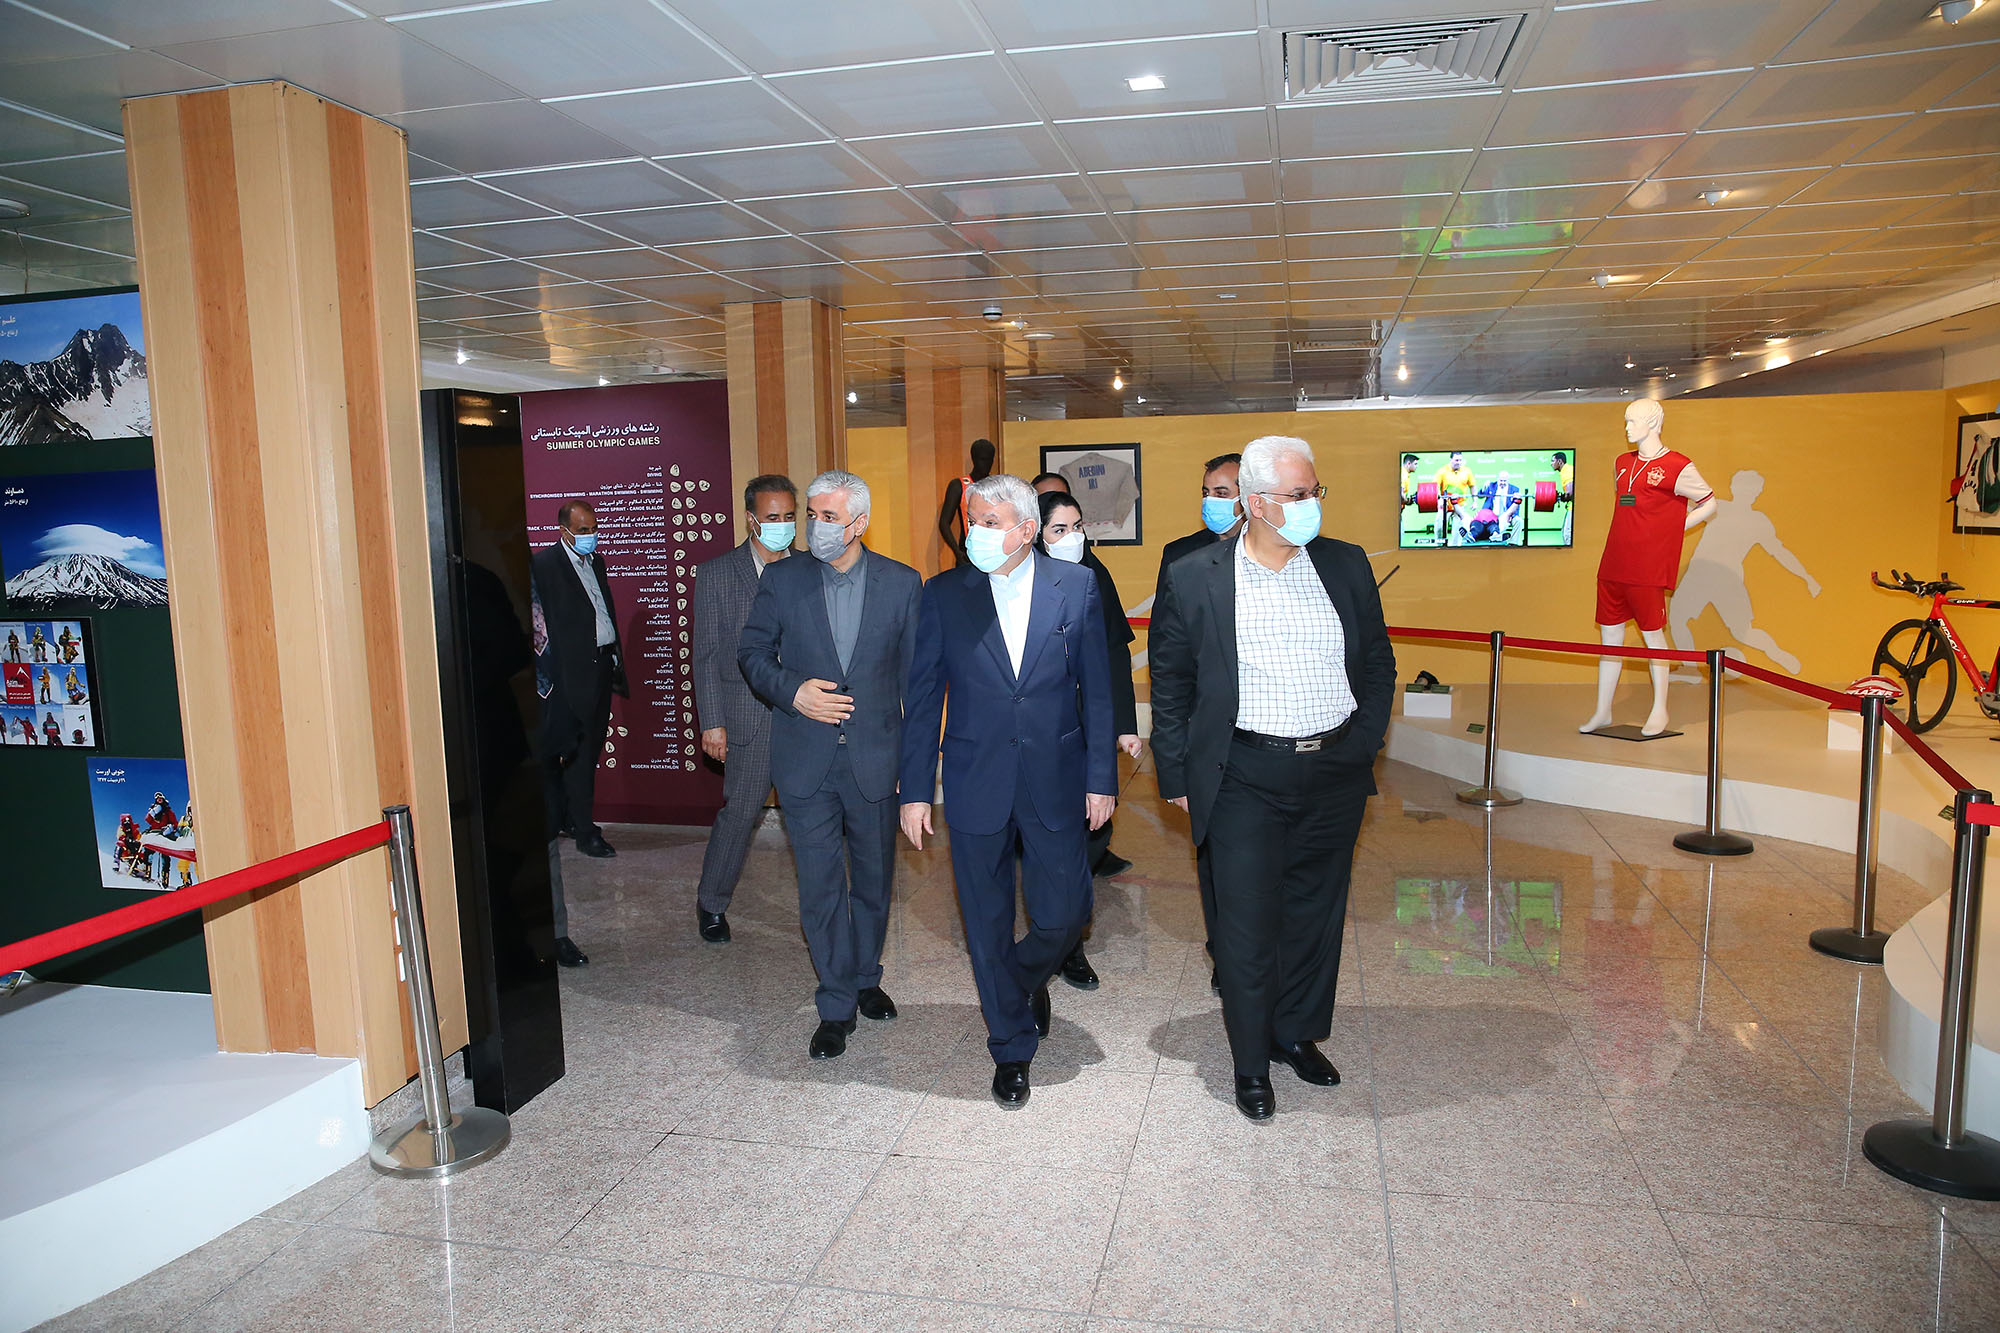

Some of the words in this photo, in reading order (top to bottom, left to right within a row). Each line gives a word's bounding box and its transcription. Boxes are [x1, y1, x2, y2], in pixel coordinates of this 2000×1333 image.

[530, 427, 562, 441] تابستانی
[563, 425, 591, 438] المپیک
[592, 425, 620, 438] ورزشی
[621, 423, 638, 435] های
[639, 422, 660, 433] رشته
[546, 440, 584, 451] SUMMER
[586, 438, 626, 448] OLYMPIC
[628, 436, 661, 446] GAMES
[5, 487, 24, 496] دماوند
[1937, 617, 1961, 652] RIDLEY
